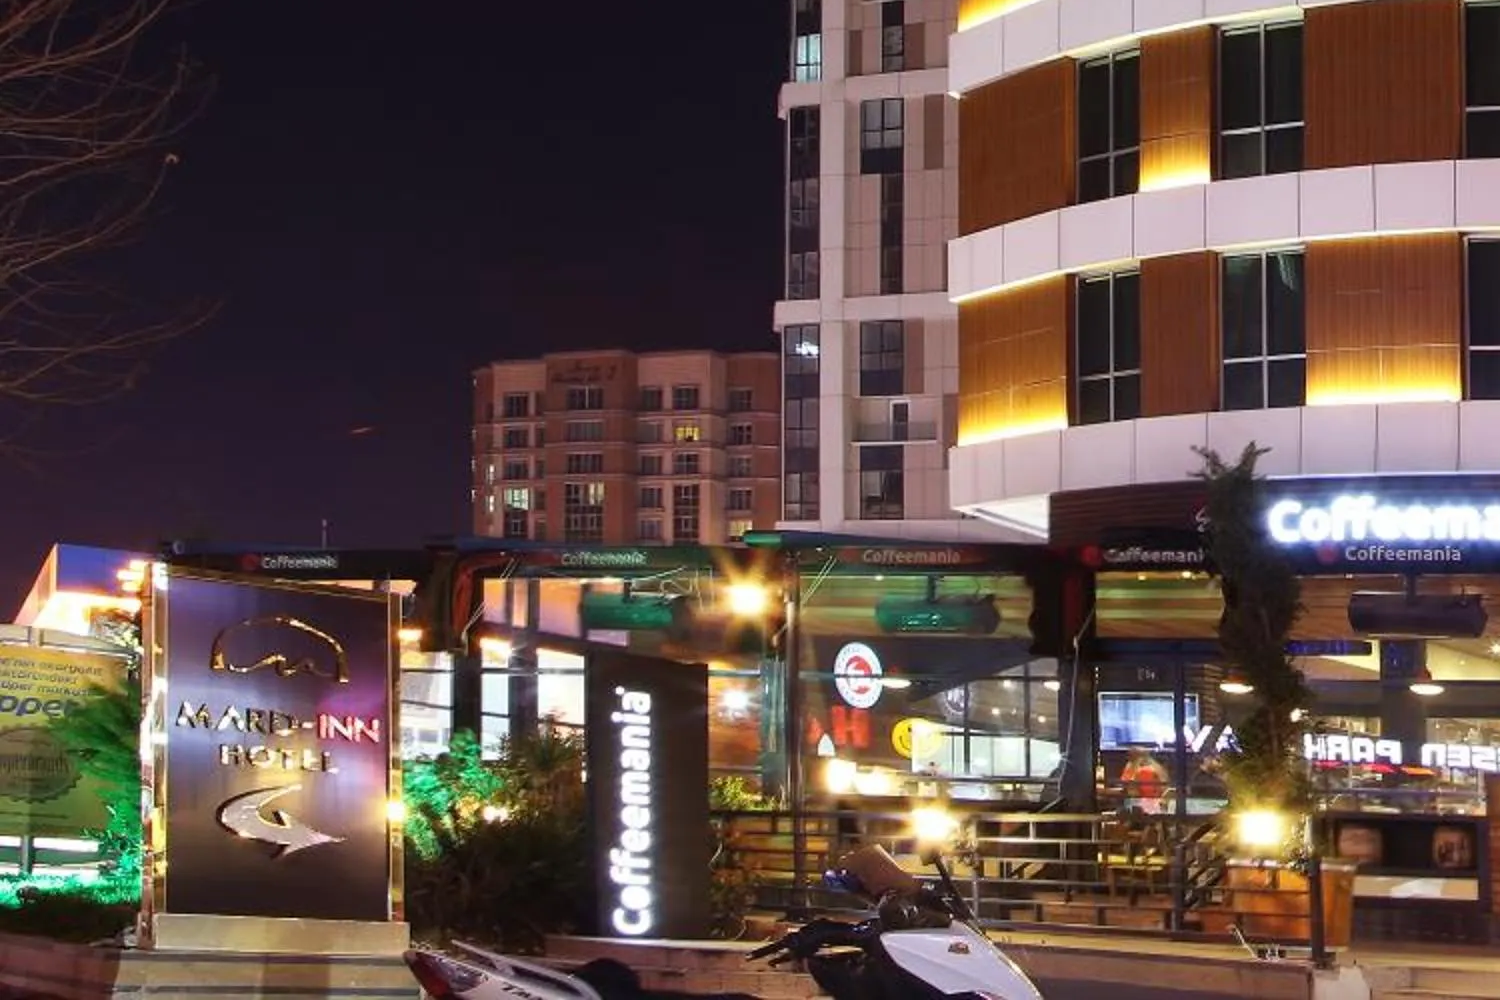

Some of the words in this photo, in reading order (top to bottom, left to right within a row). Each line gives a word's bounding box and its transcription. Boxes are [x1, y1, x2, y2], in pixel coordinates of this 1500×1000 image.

[863, 549, 961, 565] Coffeemania
[1103, 547, 1205, 563] Coffeemani
[1345, 545, 1462, 563] Coffeemania
[219, 744, 340, 775] HOTEL
[610, 690, 651, 935] Coffeemania
